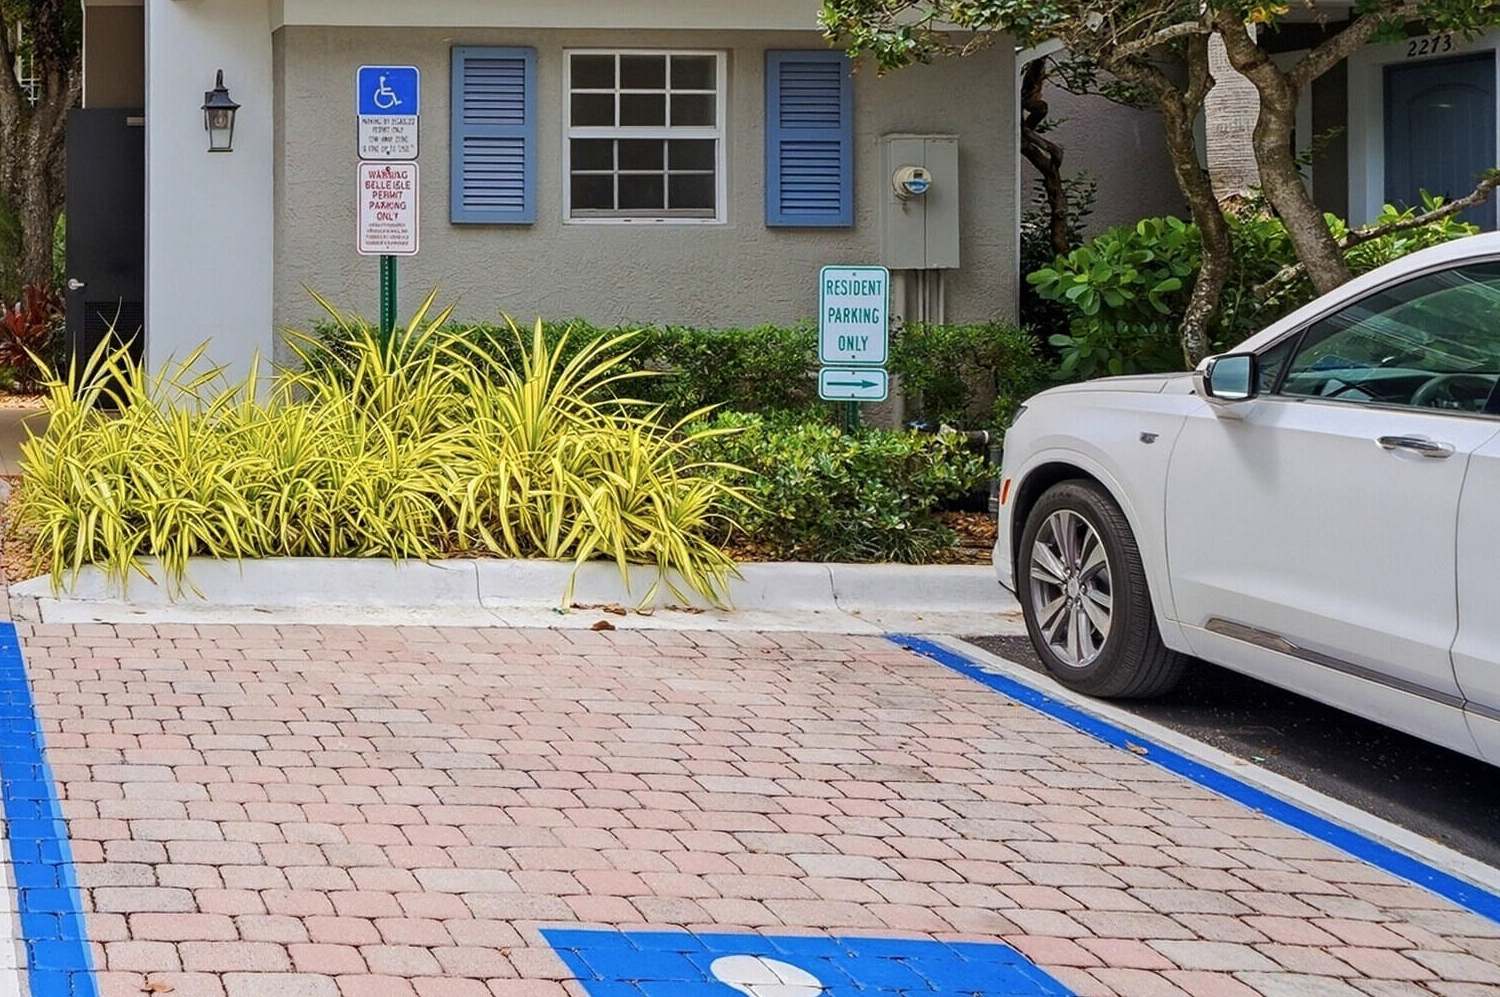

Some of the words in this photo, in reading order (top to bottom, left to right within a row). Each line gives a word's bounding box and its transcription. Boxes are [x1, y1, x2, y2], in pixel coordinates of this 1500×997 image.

[368, 201, 407, 210] PARKING
[376, 211, 399, 221] ONLY
[826, 279, 882, 296] RESIDENT
[828, 307, 880, 324] PARKING
[838, 335, 869, 352] ONLY
